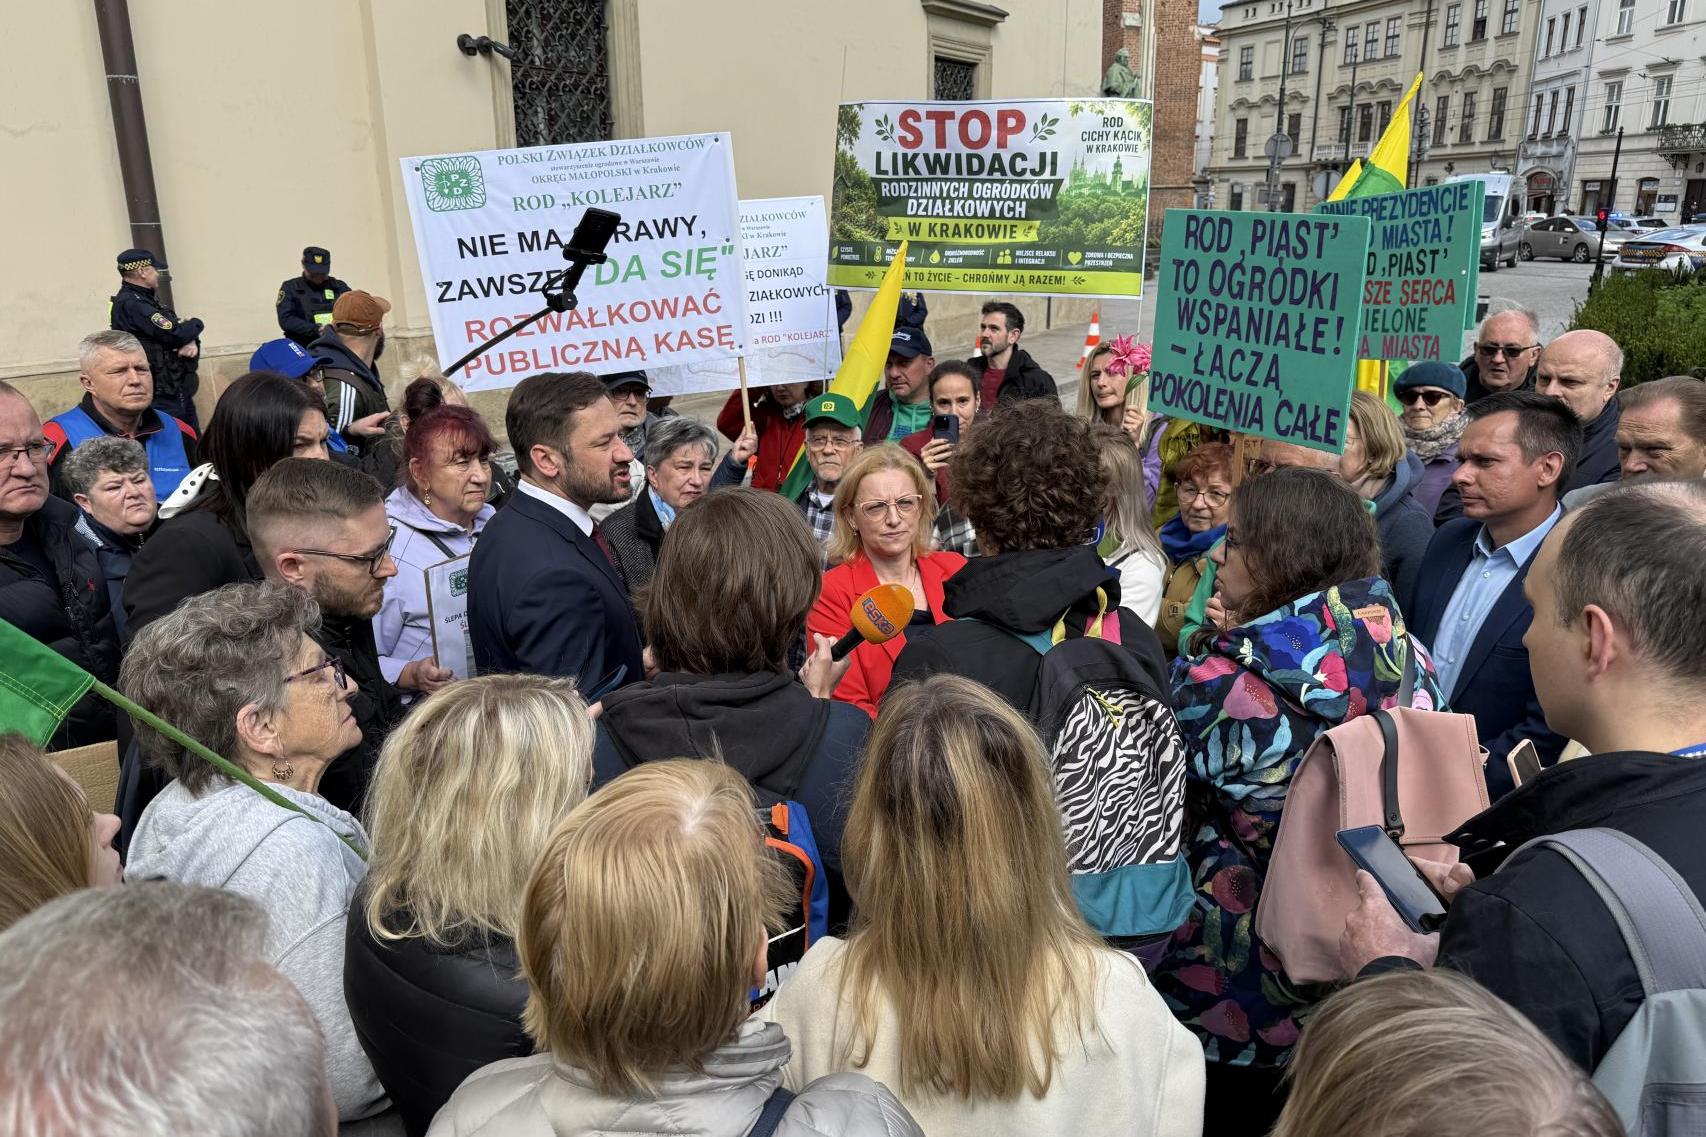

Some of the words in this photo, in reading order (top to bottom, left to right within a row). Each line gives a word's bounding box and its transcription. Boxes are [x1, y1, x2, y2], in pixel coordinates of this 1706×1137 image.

[898, 109, 1026, 150] STOP
[1103, 116, 1124, 128] ROD
[1081, 130, 1110, 142] CICHY
[1113, 130, 1142, 143] KĄCIK
[1086, 144, 1093, 153] W
[1096, 143, 1139, 153] KRAKOWIE
[497, 152, 543, 166] POLSKI
[546, 147, 607, 161] ZWIĄZEK
[610, 138, 706, 156] DZIAŁKOWCÓW
[875, 151, 1058, 177] LIKWIDACJI
[531, 174, 566, 184] OKRĘG
[569, 168, 632, 181] MAŁOPOLSKI
[643, 164, 680, 174] Krakowie
[881, 182, 968, 197] RODZINNYCH
[973, 180, 1053, 200] OGRÓDKÓW
[1362, 183, 1470, 222] PREZYDENCIE
[512, 194, 555, 212] ROD
[907, 199, 1027, 218] DZIAŁKOWYCH
[740, 210, 807, 223] ZIAŁKOWCÓW
[457, 233, 508, 259] NIE
[517, 229, 565, 253] MA
[613, 215, 706, 243] RAWY,
[757, 231, 786, 239] Krakowie
[908, 222, 921, 237] W
[928, 222, 1018, 239] KRAKOWIE
[1185, 215, 1233, 253] ROD
[436, 269, 564, 303] ZAWSZE
[592, 254, 647, 287] DA
[757, 266, 804, 279] DONIKĄD
[914, 271, 925, 281] TO
[927, 270, 953, 282] ŻYCIE
[962, 271, 1010, 284] CHROŃMY
[1013, 274, 1025, 287] JĄ
[1029, 274, 1066, 285] RAZEM!
[1172, 258, 1200, 294] TO
[1209, 257, 1339, 310] OGRÓDKI
[749, 283, 829, 301] ZIAŁKOWYCH
[1363, 279, 1392, 305] SZE
[1400, 278, 1455, 306] SERCA
[465, 288, 722, 343] ROZWAŁKOWAĆ
[1177, 297, 1344, 355] WSPANIAŁE!
[1365, 308, 1428, 333] IELONE
[761, 334, 781, 344] ROD
[1382, 335, 1440, 361] MIASTA
[464, 336, 647, 379] PUBLICZNĄ
[654, 325, 735, 354] KASĘ
[1193, 341, 1284, 399] ŁĄCZĄ
[1150, 371, 1264, 432] POKOLENIA
[1274, 399, 1341, 446] CAŁE
[444, 612, 462, 624] ŚLEPA
